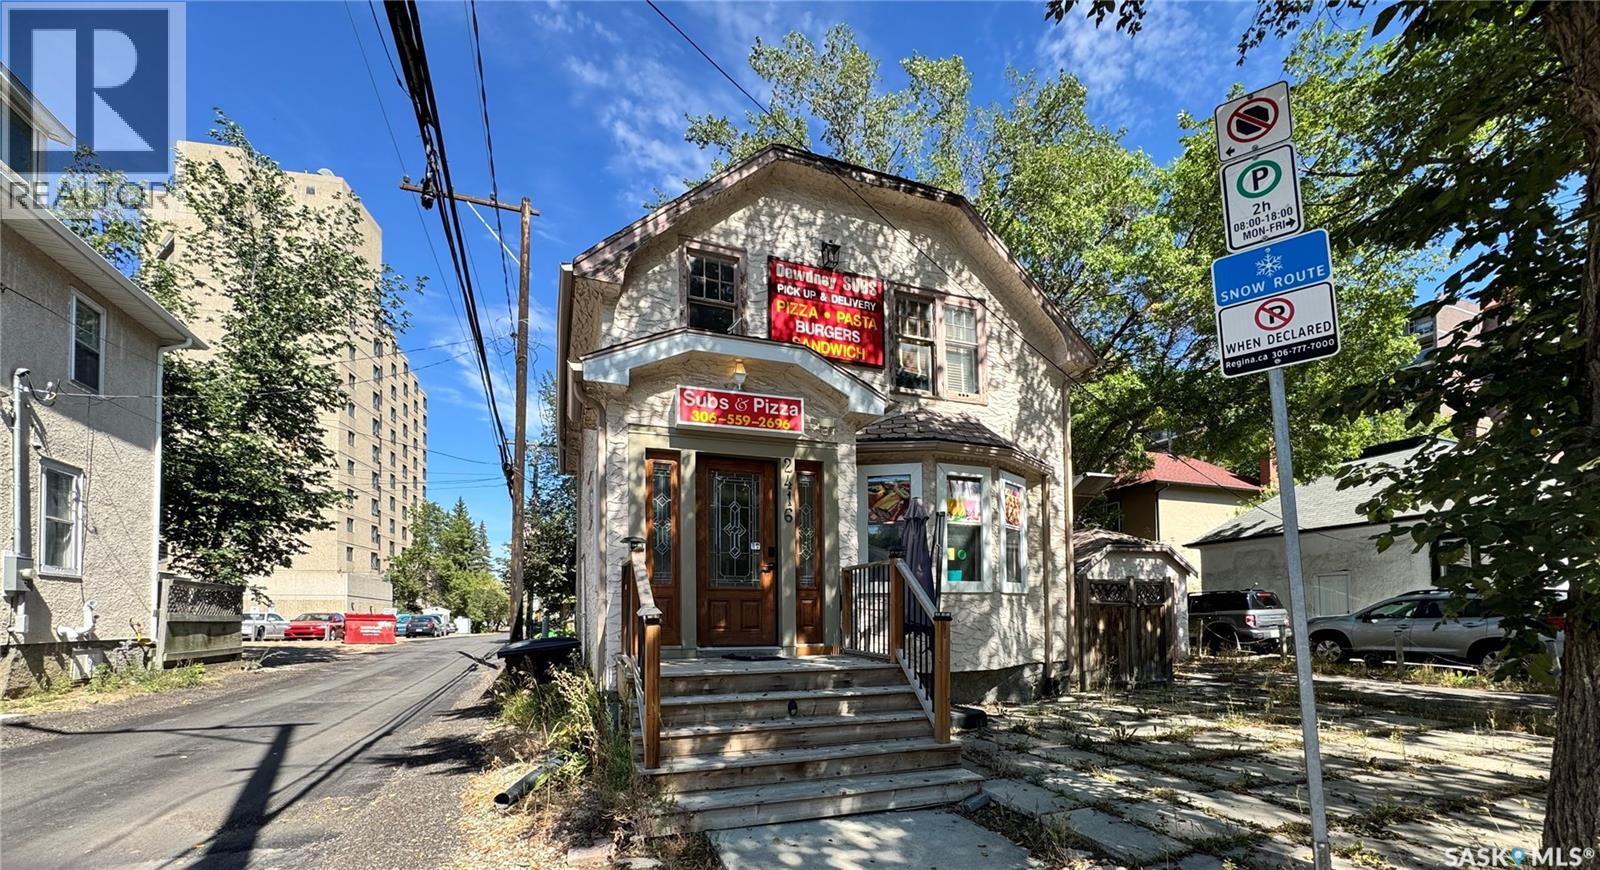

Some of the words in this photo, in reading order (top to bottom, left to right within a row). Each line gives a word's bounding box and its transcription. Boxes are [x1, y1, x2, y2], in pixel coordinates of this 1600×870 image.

[1252, 166, 1269, 191] P
[1233, 206, 1293, 232] 08:00-18:00
[1252, 201, 1271, 215] 2h
[1242, 220, 1286, 240] MON-FRI
[1221, 281, 1265, 302] SNOW
[1273, 264, 1326, 288] ROUTE
[777, 284, 801, 297] PICK
[803, 289, 816, 299] UP
[820, 292, 828, 302] &
[831, 294, 876, 311] DELIVERY
[776, 300, 819, 320] PIZZA
[836, 311, 877, 330] PASTA
[795, 320, 861, 343] BURGERS
[1225, 337, 1261, 354] WHEN
[1267, 321, 1332, 345] DECLARED
[1225, 354, 1268, 368] Regina.ca
[1272, 338, 1335, 359] 306-777-7000
[683, 390, 729, 410] Subs
[735, 397, 749, 412] &
[753, 398, 799, 417] Pizza
[691, 409, 791, 430] 306-559-2696
[784, 457, 793, 523] 2416
